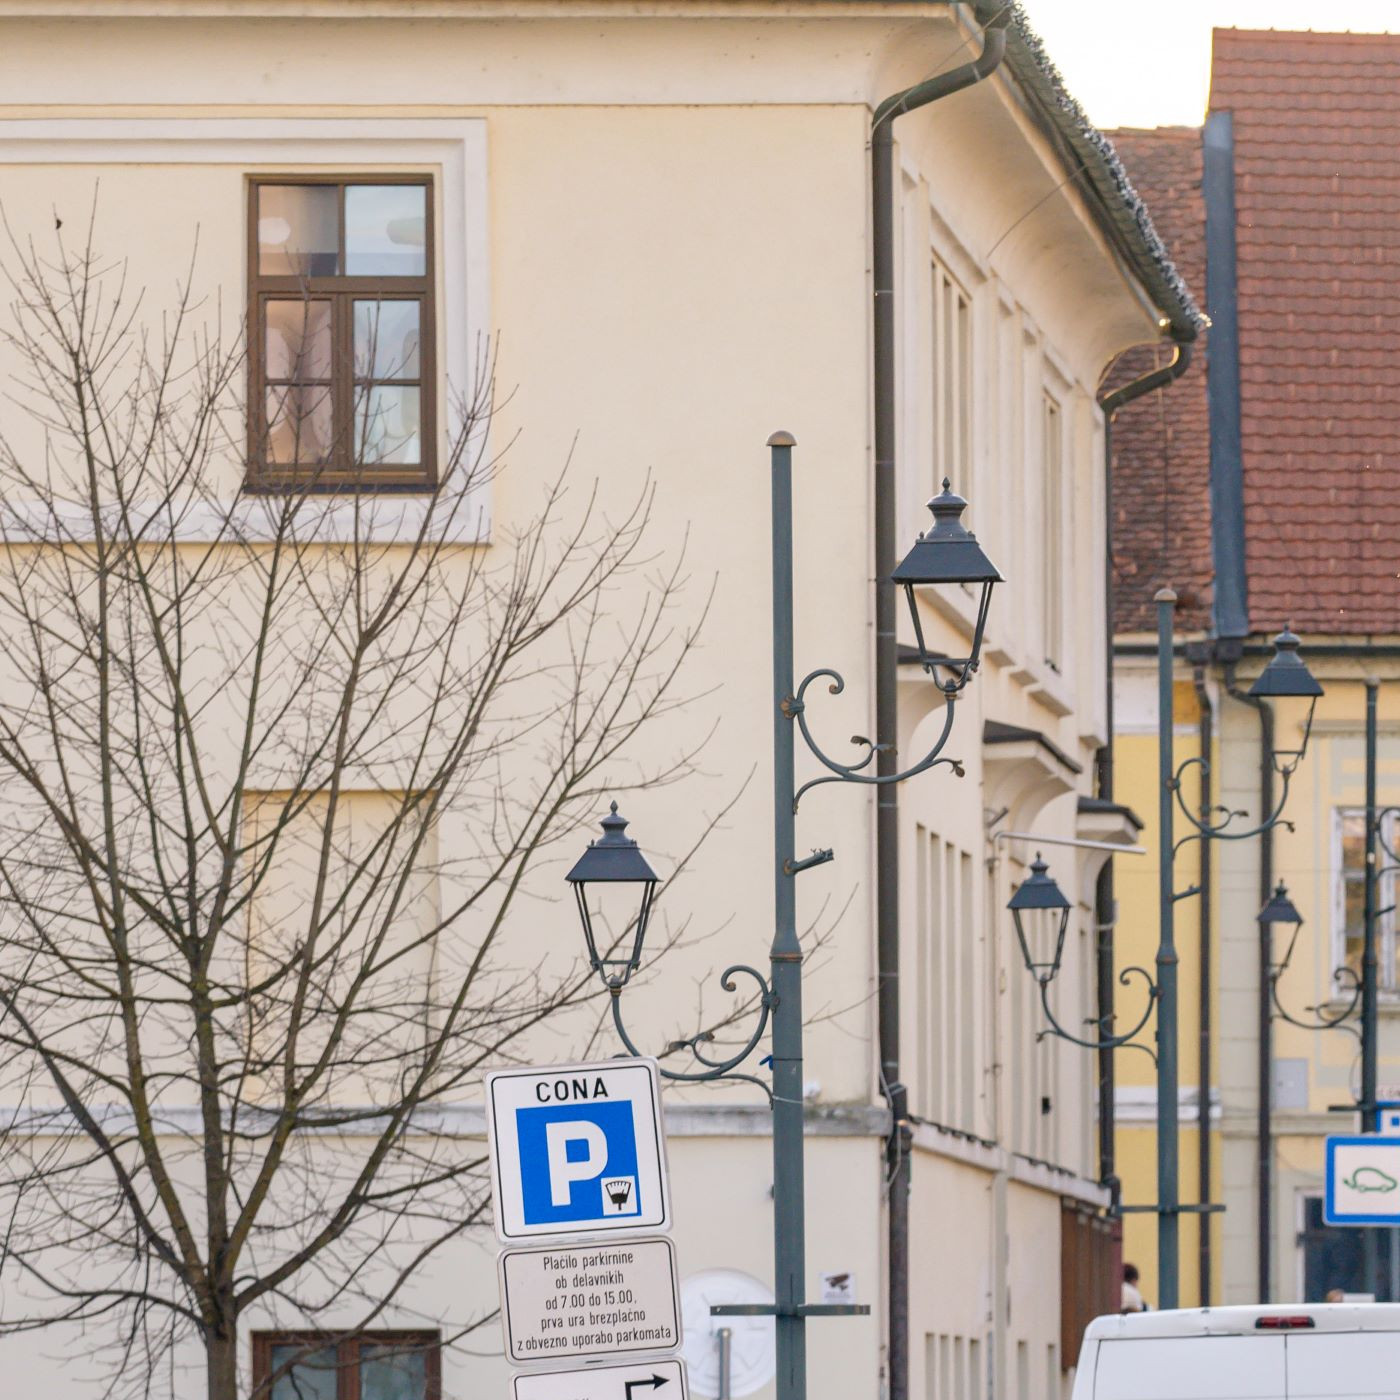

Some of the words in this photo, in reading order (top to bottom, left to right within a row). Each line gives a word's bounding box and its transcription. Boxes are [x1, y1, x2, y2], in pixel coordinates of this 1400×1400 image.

[536, 1077, 609, 1103] CONA
[545, 1120, 609, 1207] P
[543, 1255, 578, 1271] Plačilo
[582, 1251, 634, 1271] parkirnine
[555, 1275, 568, 1289] ob
[572, 1270, 624, 1288] delavnikih
[545, 1296, 558, 1310] od
[561, 1294, 585, 1309] 7.00
[588, 1293, 601, 1307] do
[541, 1316, 563, 1333] prva
[568, 1314, 585, 1327] ura
[590, 1309, 646, 1327] brezplačno
[517, 1340, 524, 1351] z
[526, 1336, 568, 1350] obvezno
[572, 1331, 613, 1349] uporabo
[616, 1325, 671, 1347] parkomata
